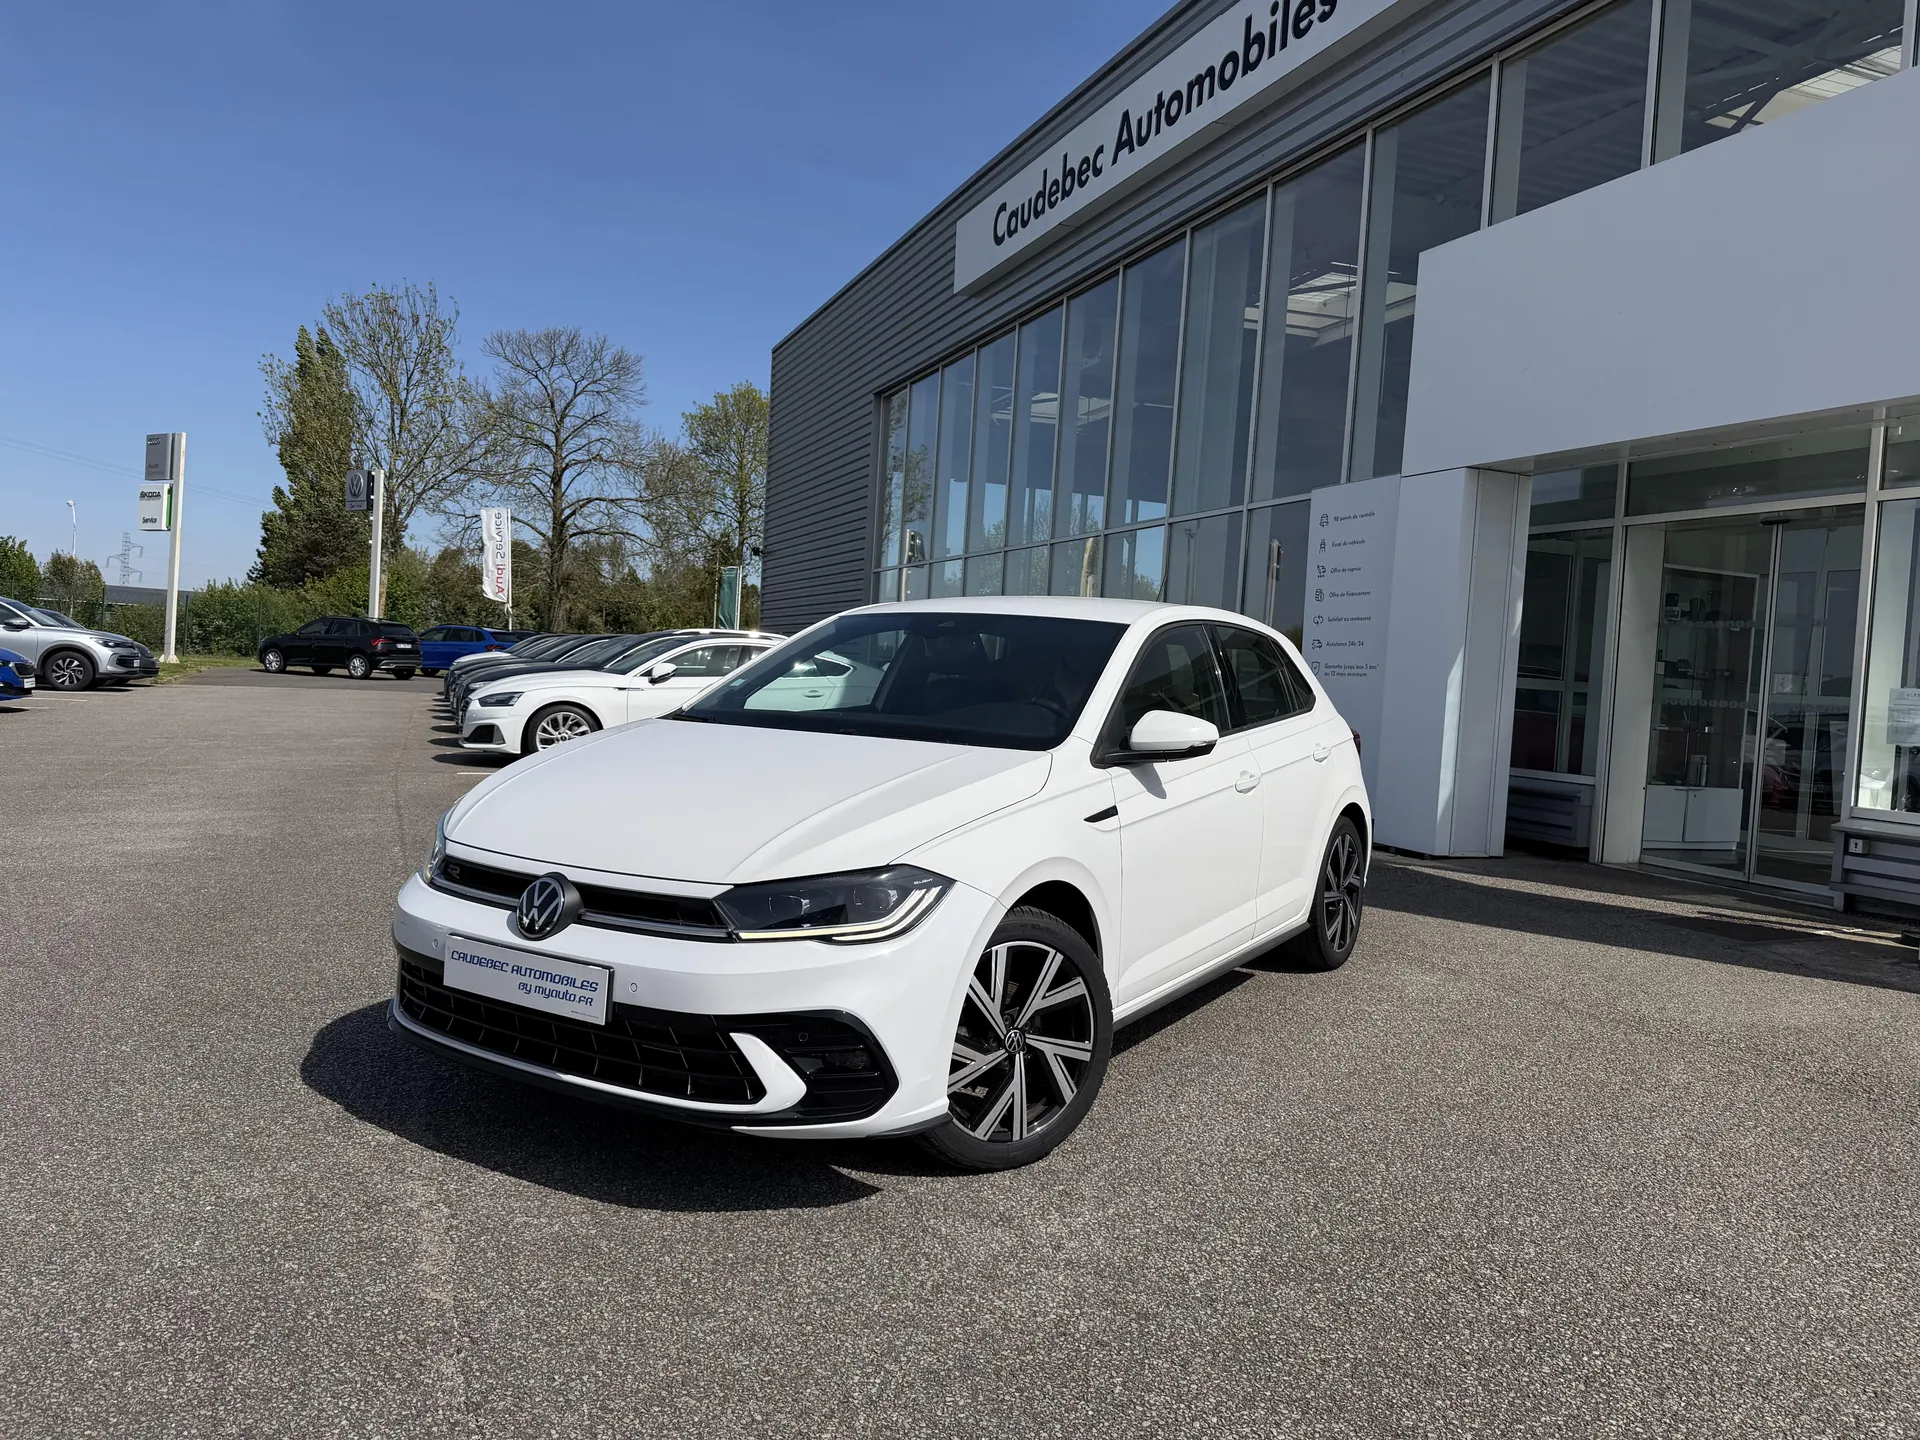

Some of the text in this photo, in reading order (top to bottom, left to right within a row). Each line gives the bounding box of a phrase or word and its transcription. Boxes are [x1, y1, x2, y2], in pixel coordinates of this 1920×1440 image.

[993, 142, 1104, 246] Caudebec
[1324, 662, 1343, 670] Garantie
[450, 950, 599, 993] CAUDEBEC AUTOMOBILES
